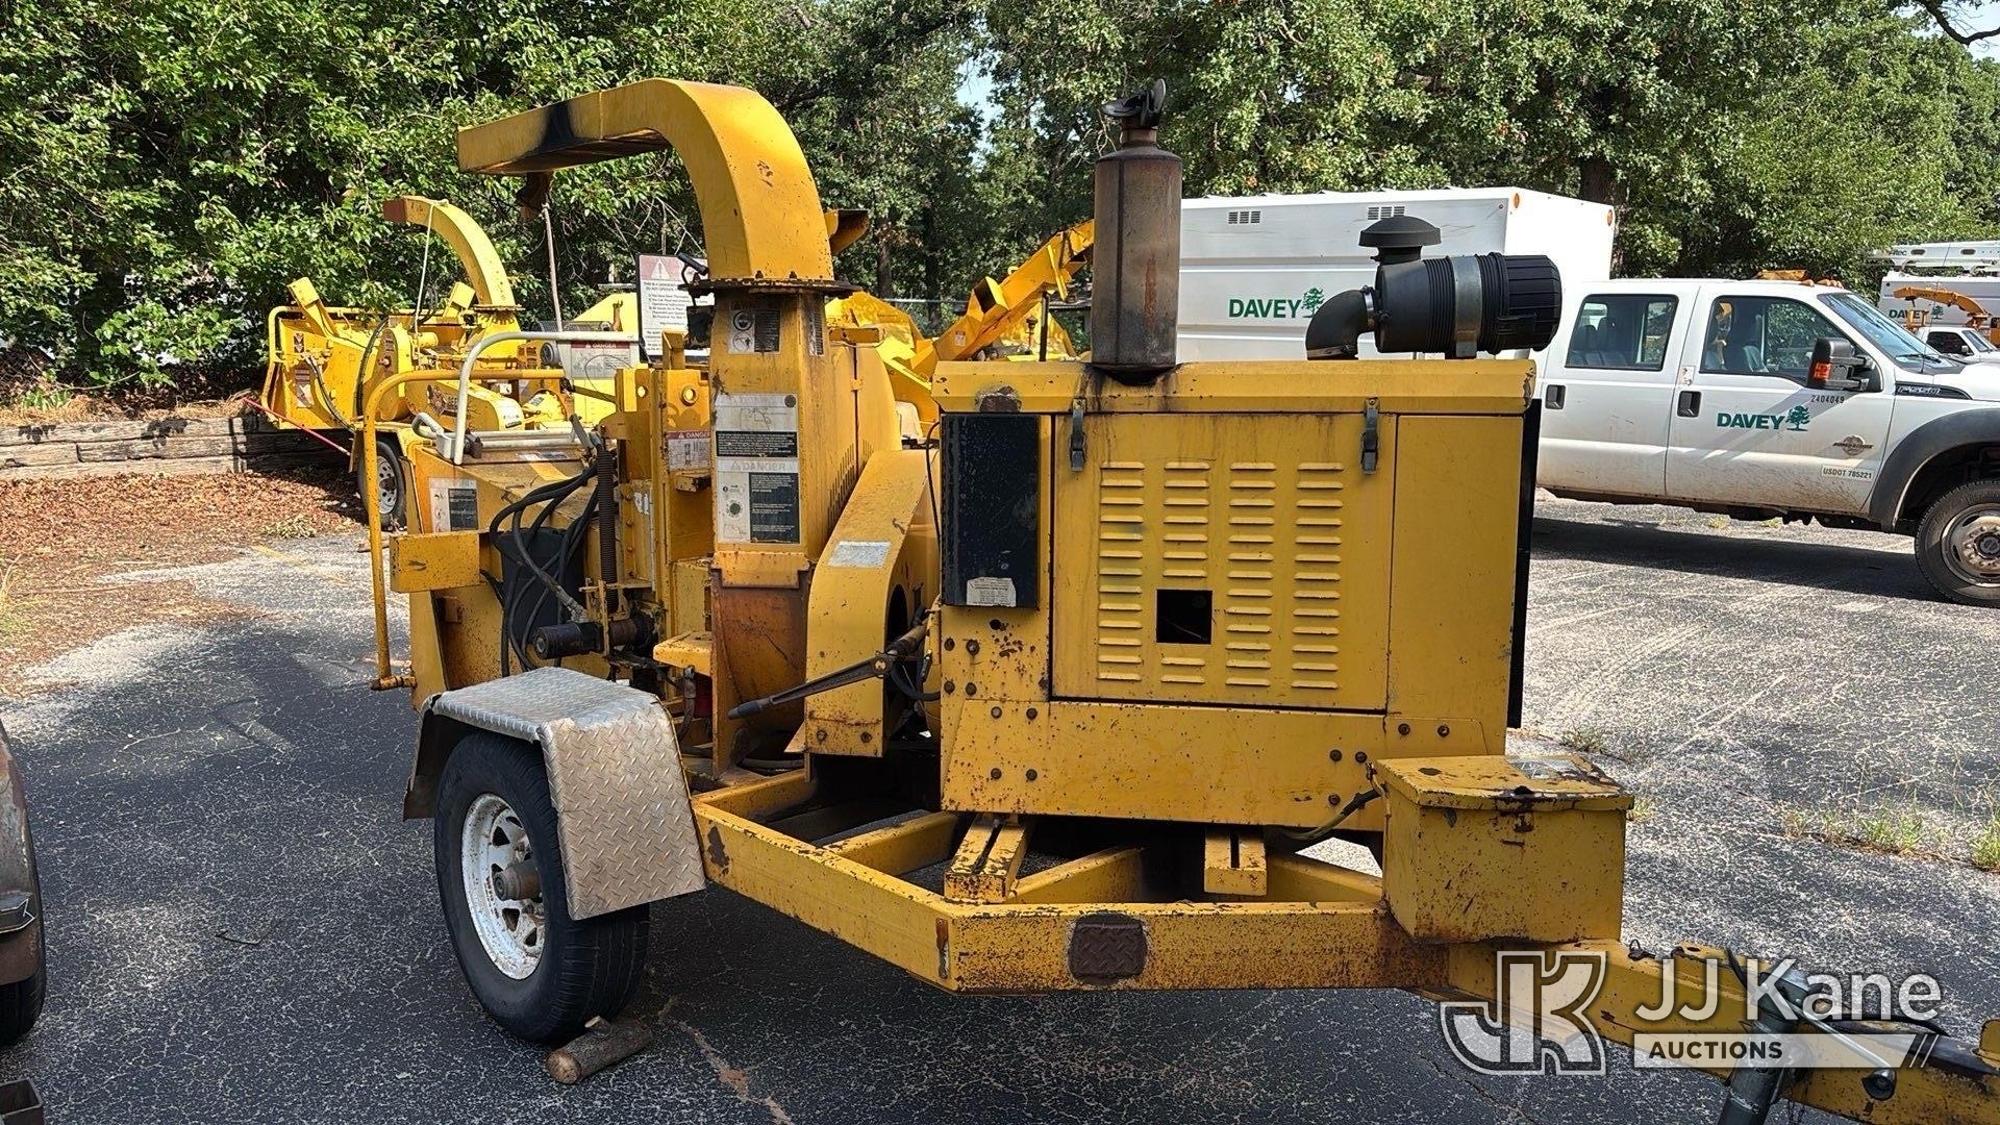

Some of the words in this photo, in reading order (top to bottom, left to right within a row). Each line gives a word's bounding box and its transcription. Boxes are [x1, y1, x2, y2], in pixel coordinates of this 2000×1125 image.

[1229, 298, 1302, 318] DAVEY
[1889, 309, 1929, 319] DAE
[1811, 394, 1845, 404] 2404049
[1717, 412, 1786, 430] DAVEY
[686, 431, 710, 439] DANGE
[1823, 467, 1846, 477] USDOT
[1848, 470, 1872, 479] 785221
